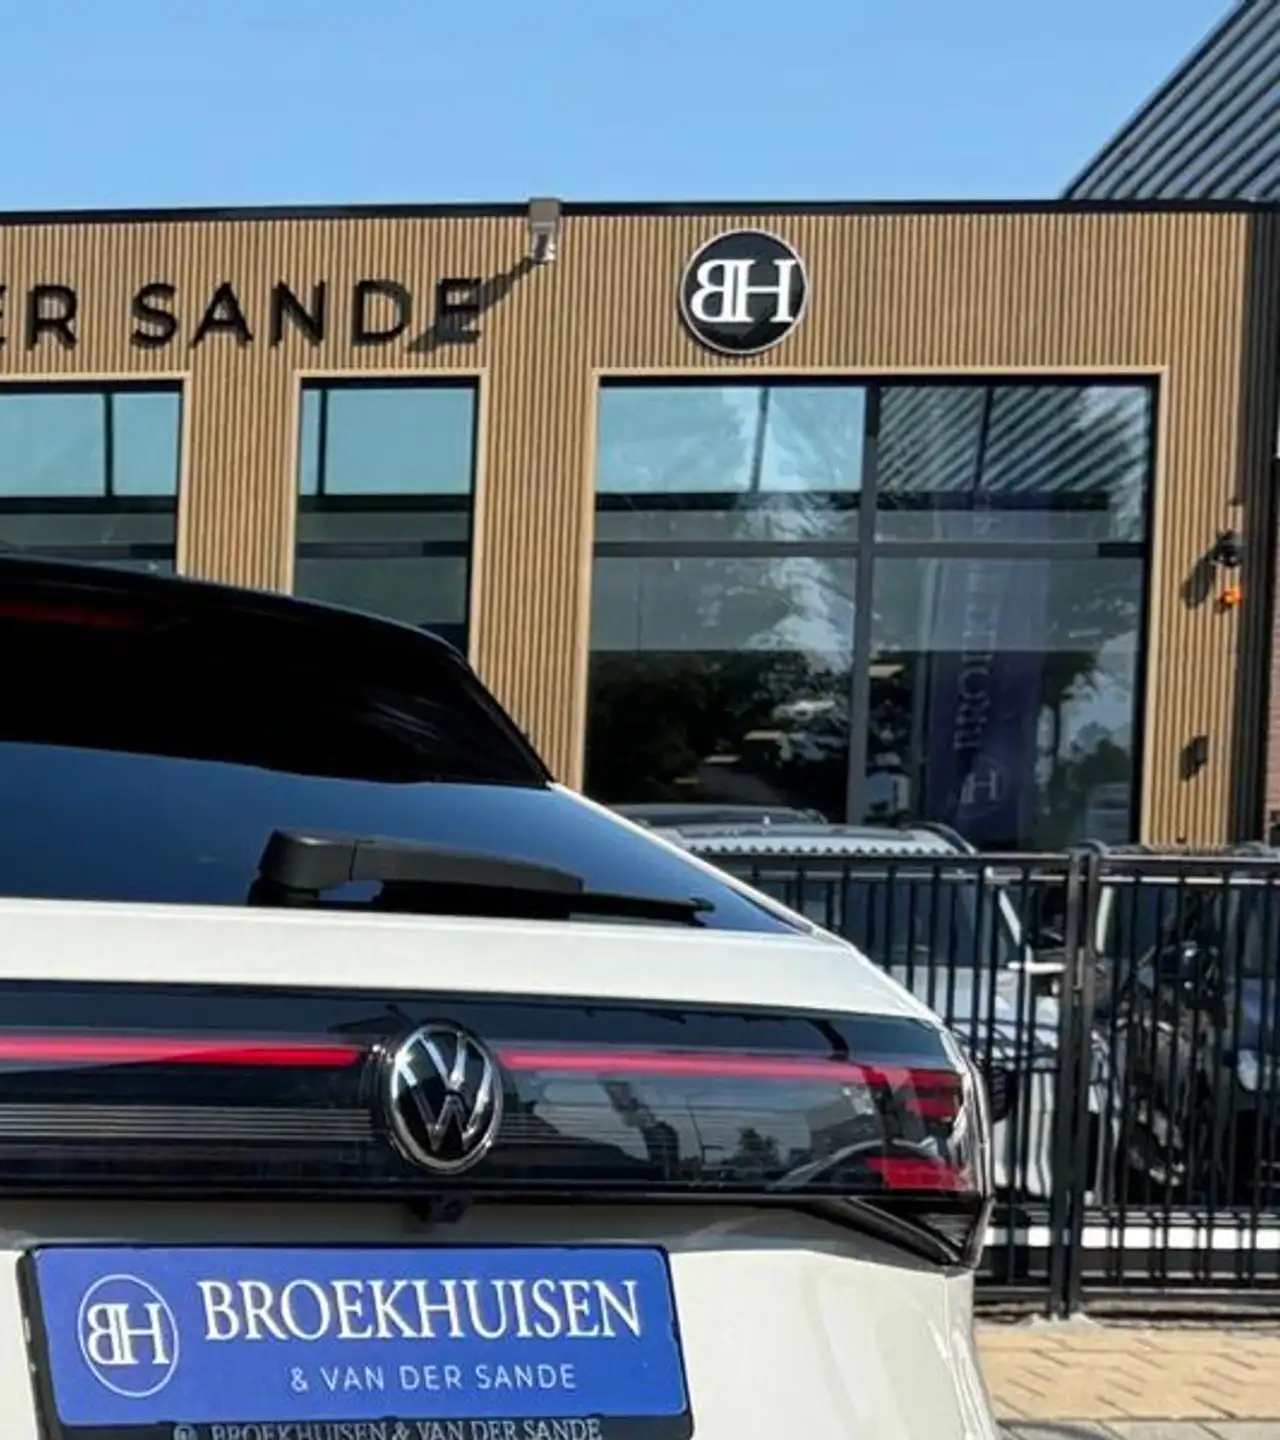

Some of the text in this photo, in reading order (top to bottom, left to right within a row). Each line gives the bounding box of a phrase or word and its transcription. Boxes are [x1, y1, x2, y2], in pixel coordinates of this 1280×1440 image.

[129, 277, 481, 352] SANDE
[196, 1278, 641, 1341] BROEKHUISEN
[290, 1362, 577, 1393] & VAN DER SANDE
